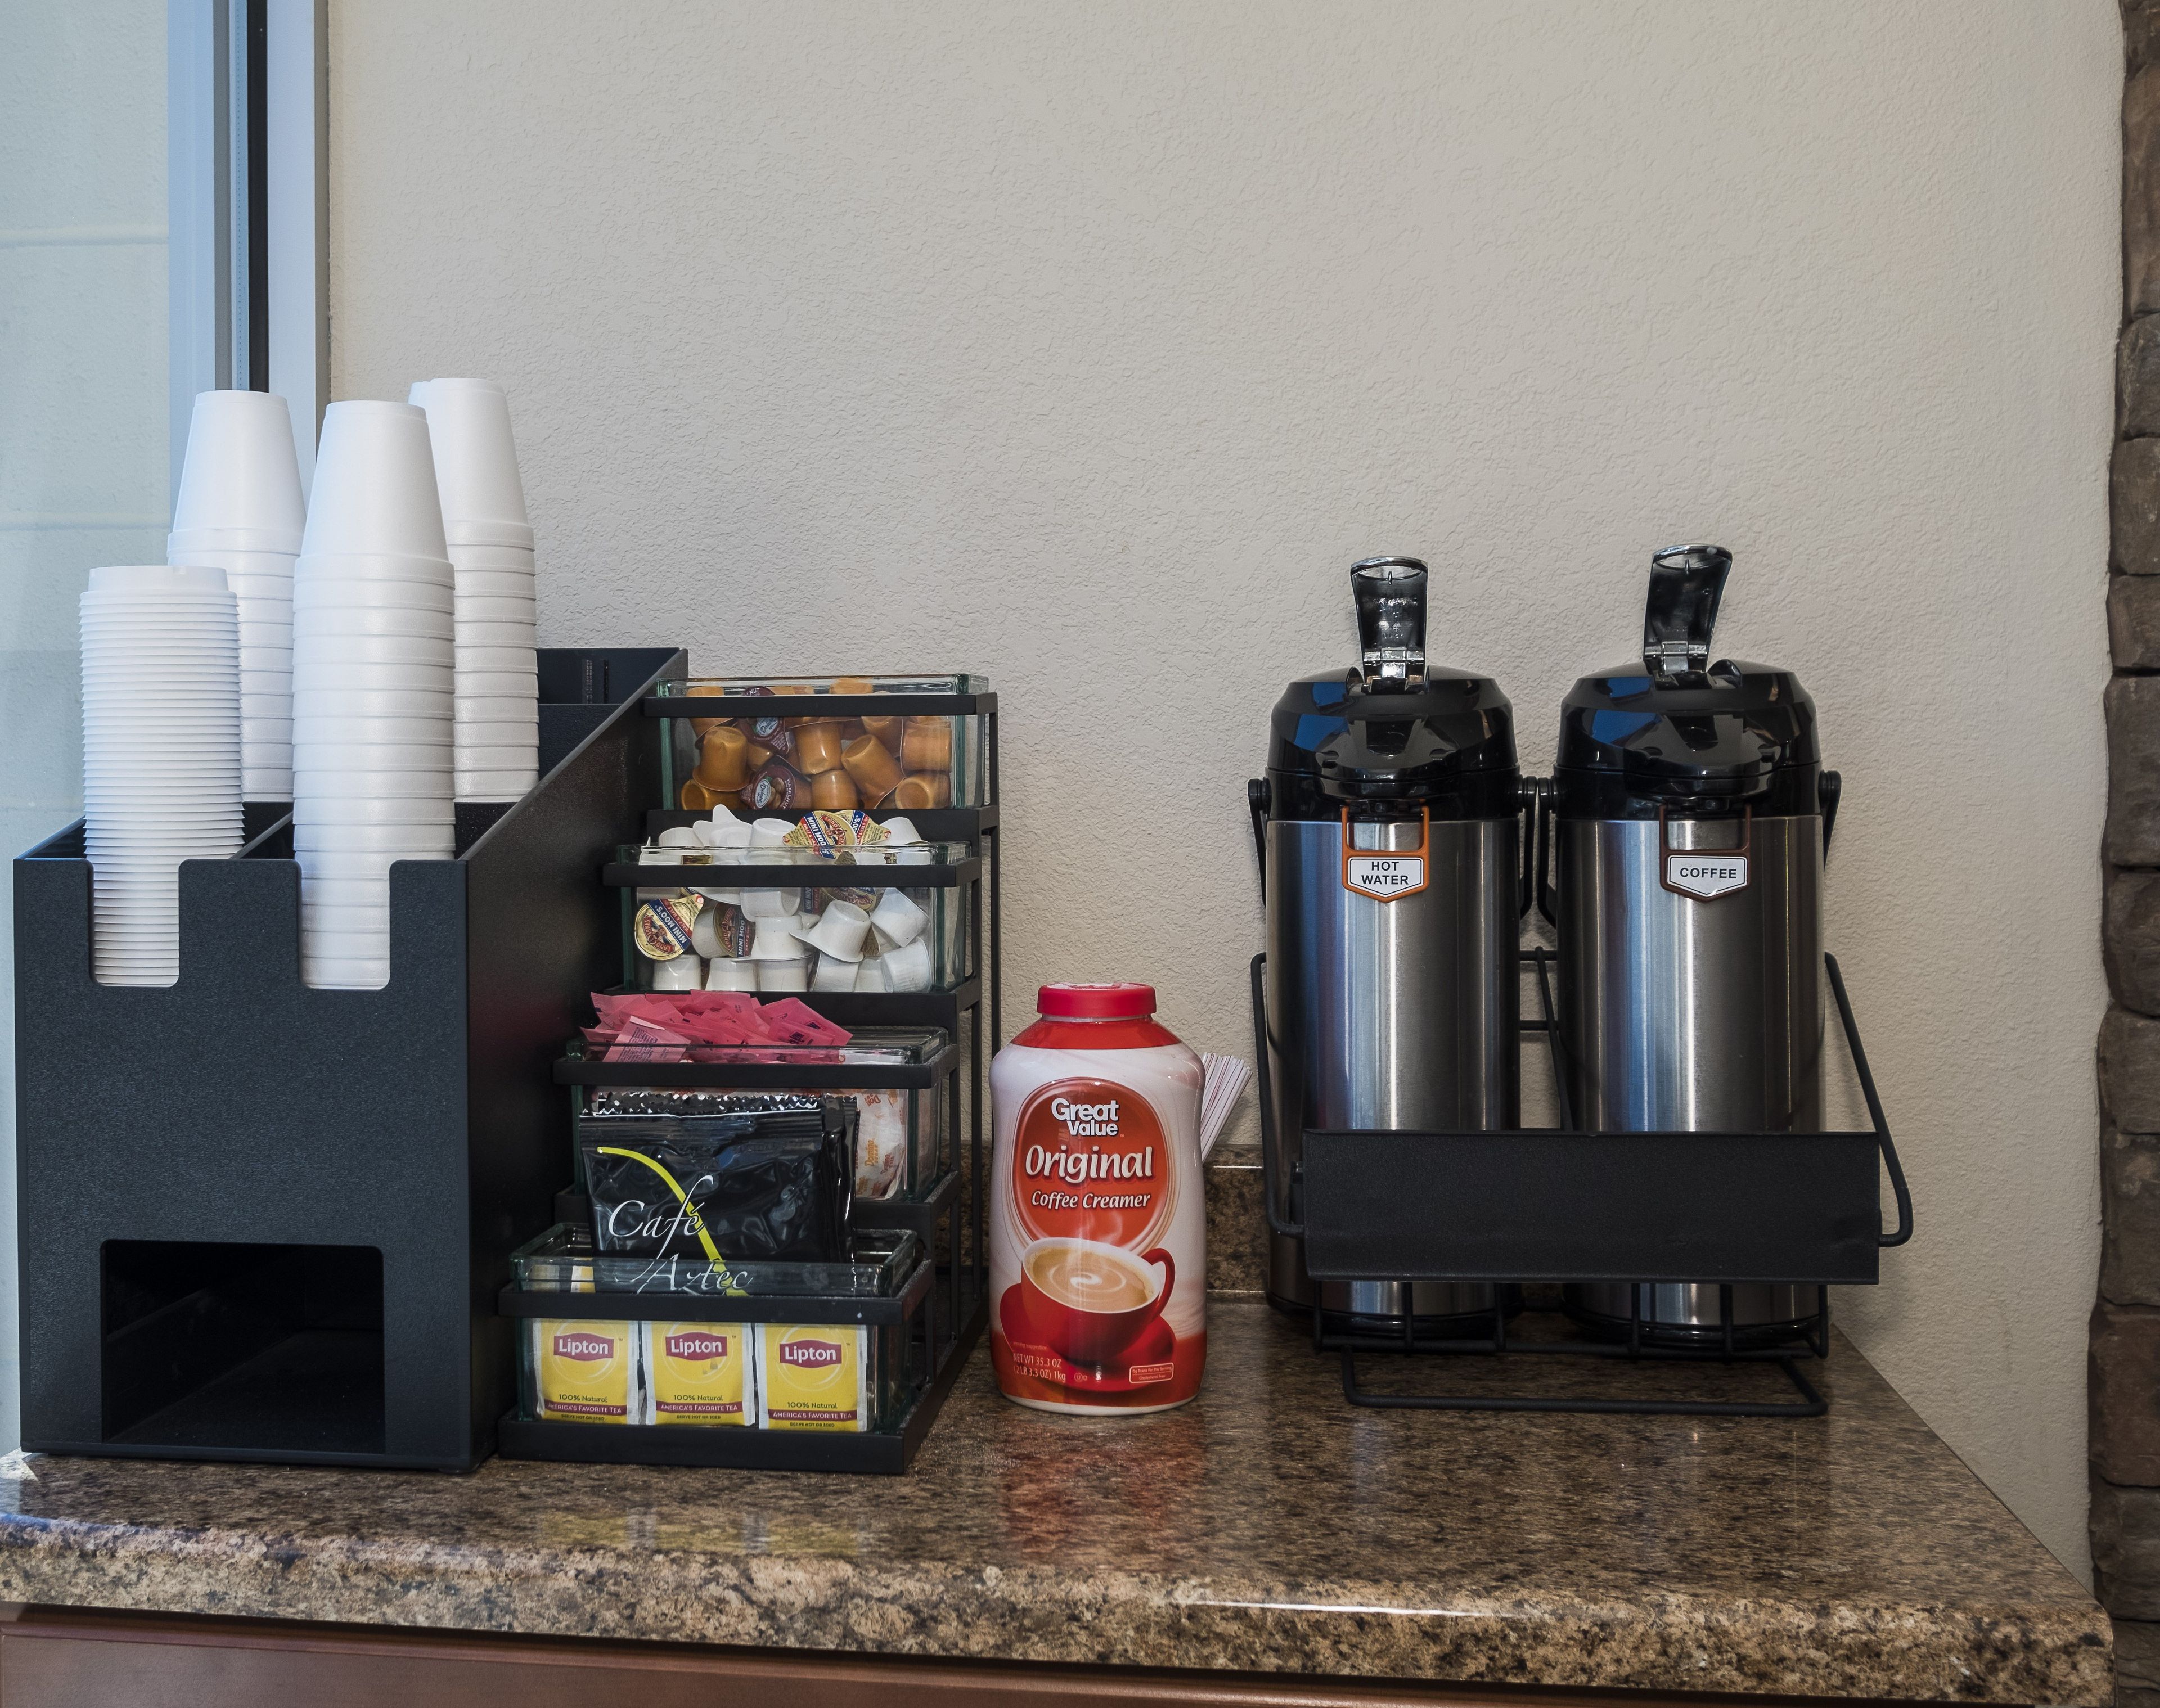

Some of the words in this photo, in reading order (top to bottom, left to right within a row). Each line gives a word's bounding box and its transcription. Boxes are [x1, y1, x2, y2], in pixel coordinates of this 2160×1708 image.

[782, 778, 792, 810] HAZELNUT
[807, 817, 818, 832] MINI
[1371, 862, 1399, 871] HOT
[1680, 868, 1736, 878] COFFEE
[1361, 875, 1408, 885] WATER
[656, 906, 675, 928] MOO'S
[644, 920, 652, 935] LAKES
[672, 927, 687, 944] MINI
[655, 942, 671, 952] LAND
[1051, 1098, 1119, 1121] Great
[1067, 1120, 1118, 1136] Value
[1026, 1145, 1153, 1183] Original
[1032, 1191, 1078, 1209] Coffee
[1083, 1193, 1150, 1208] Creamer
[636, 1253, 754, 1295] Aztec
[559, 1338, 608, 1355] Lipton
[671, 1339, 722, 1356] Lipton
[785, 1346, 836, 1363] Lipton
[1013, 1353, 1023, 1362] NET
[1024, 1355, 1034, 1364] WT
[1036, 1357, 1050, 1366] 35.3
[1052, 1359, 1061, 1368] OZ
[1014, 1365, 1019, 1373] (2
[1020, 1366, 1027, 1375] LB
[1029, 1368, 1038, 1377] 3.3
[1040, 1369, 1051, 1380] OZ)
[1055, 1371, 1065, 1381] 1kg
[548, 1403, 577, 1411] AMERICA'S
